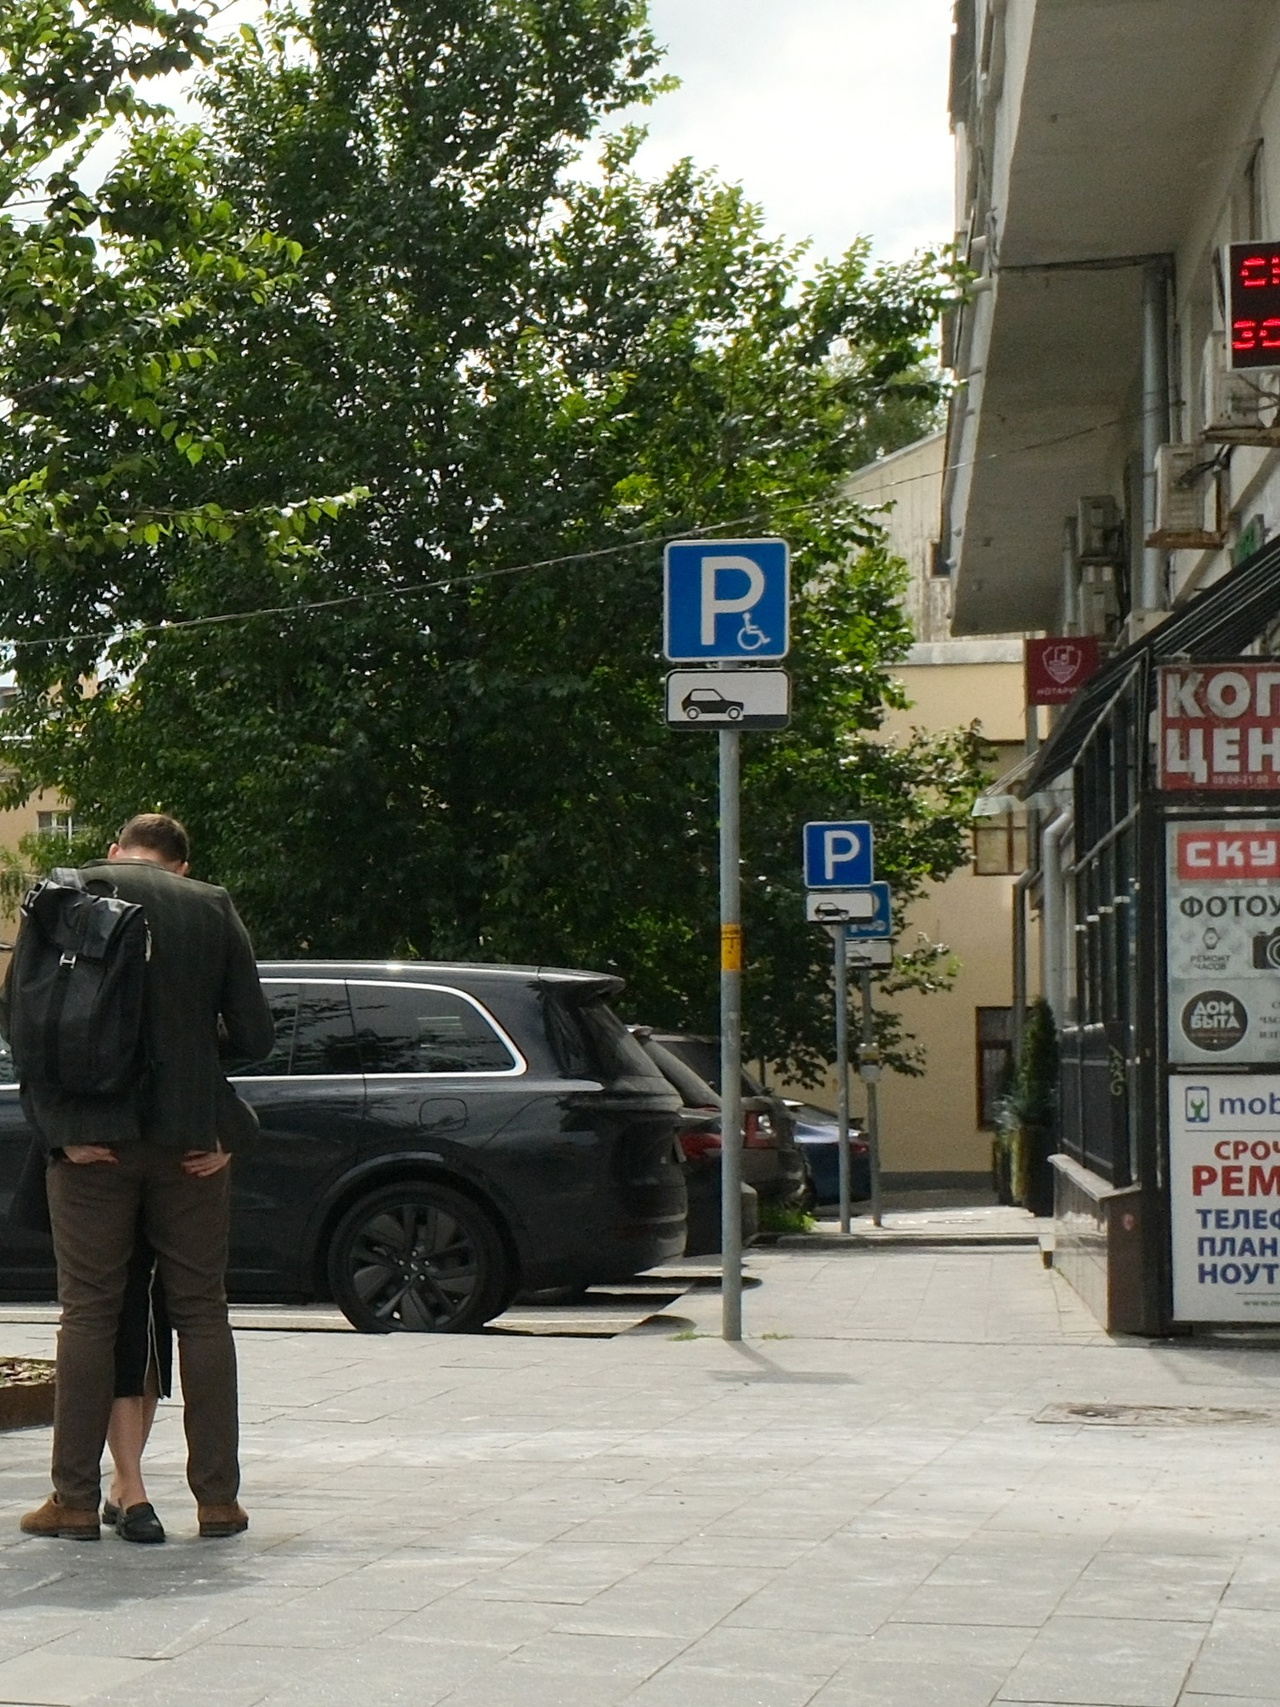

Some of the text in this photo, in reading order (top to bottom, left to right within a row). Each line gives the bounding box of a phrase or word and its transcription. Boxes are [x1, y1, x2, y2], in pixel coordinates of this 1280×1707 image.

[700, 556, 765, 645] P
[1036, 687, 1077, 696] НОТАРИ
[1166, 727, 1280, 784] ЦЕН
[824, 830, 860, 879] P
[1186, 841, 1276, 867] СКУ
[1194, 1001, 1235, 1015] ДОМ
[1190, 1015, 1241, 1029] БЫТА
[1192, 1165, 1280, 1196] РЕМ
[1198, 1237, 1278, 1257] ПЛАН
[1198, 1263, 1279, 1284] НОУТ
